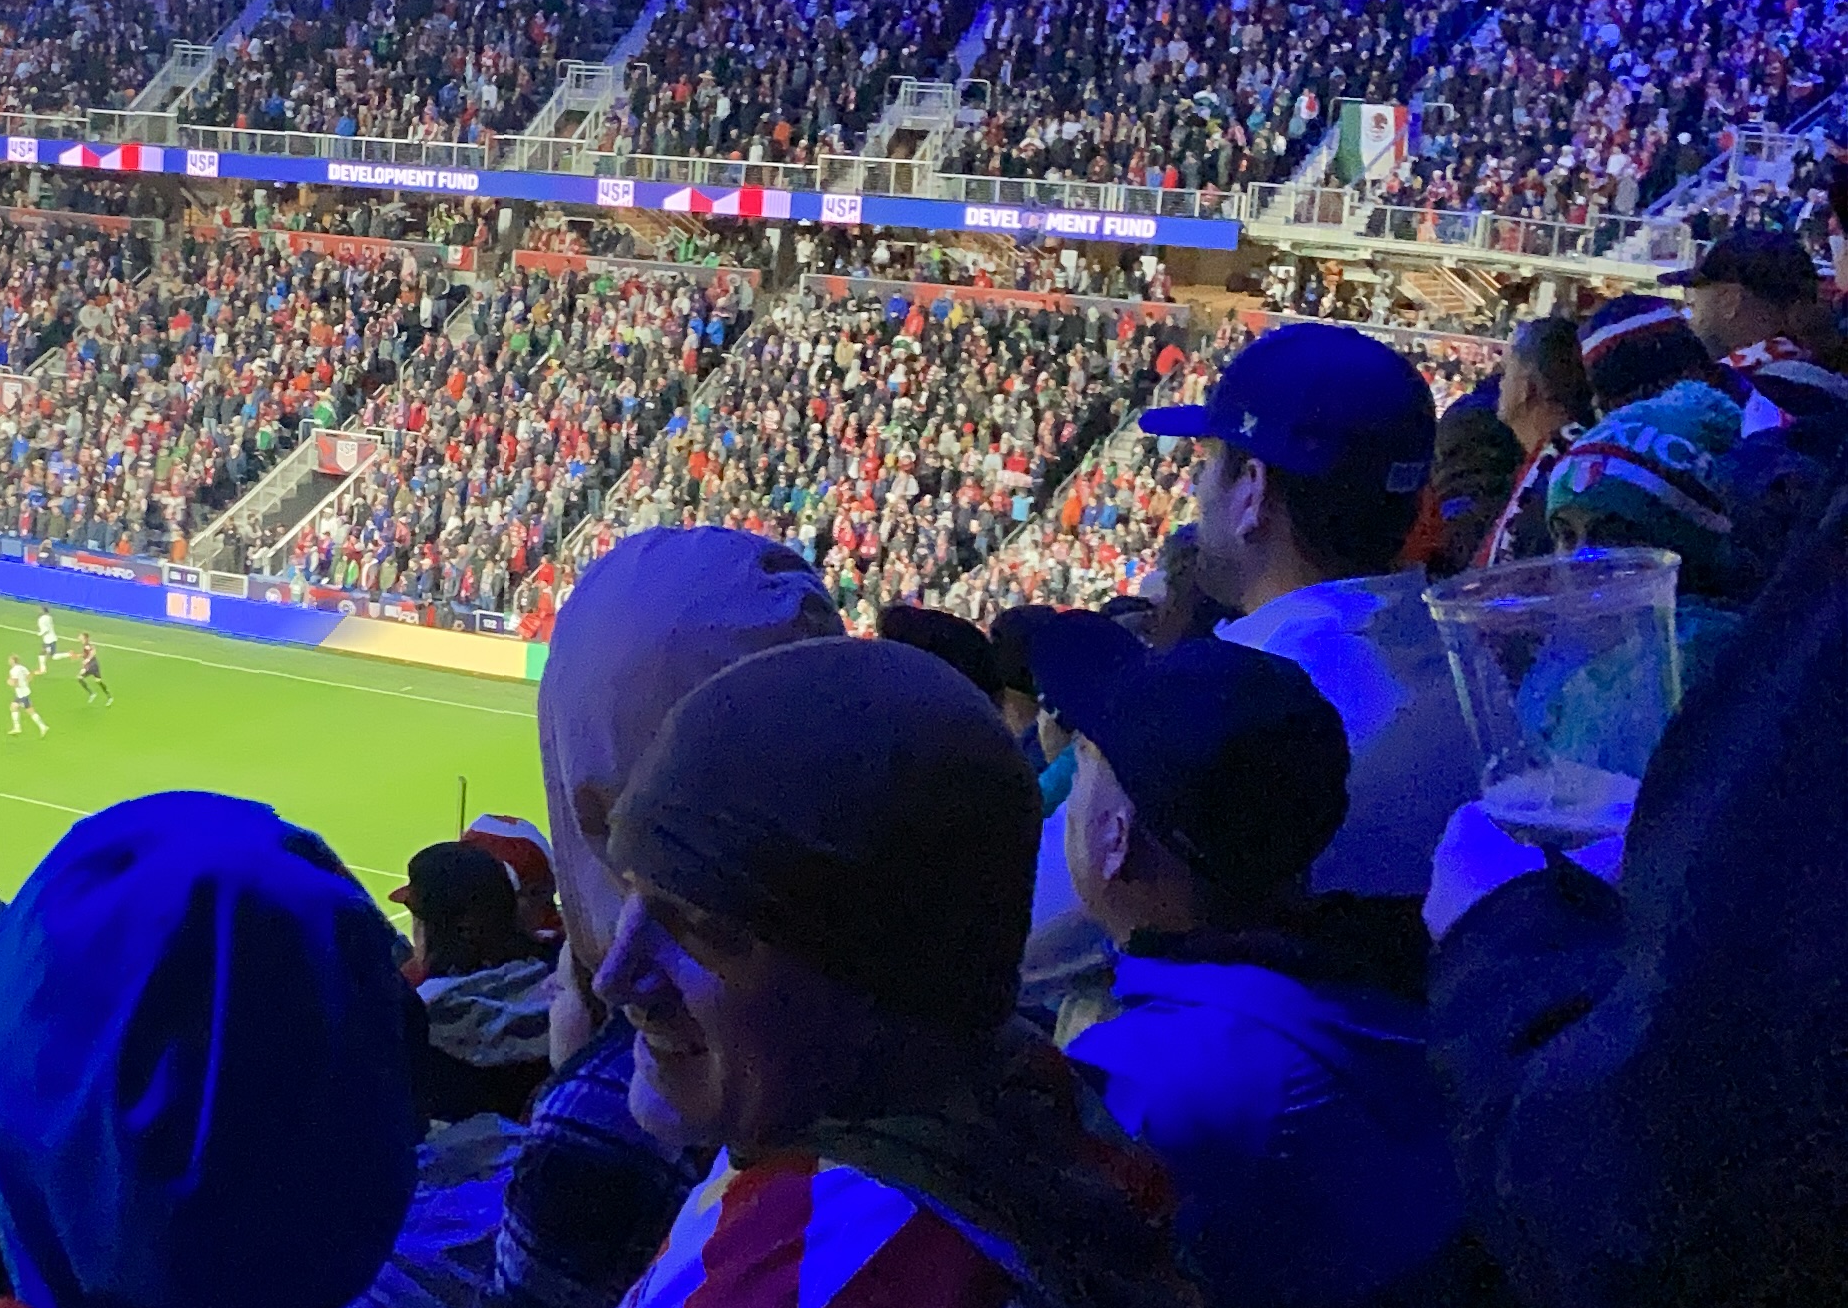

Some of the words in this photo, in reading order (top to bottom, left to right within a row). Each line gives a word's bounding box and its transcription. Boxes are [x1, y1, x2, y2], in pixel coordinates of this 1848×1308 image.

[189, 153, 216, 173] USA
[327, 162, 437, 188] DEVELOPMENT
[438, 170, 479, 192] FUND
[601, 182, 630, 200] USA
[825, 198, 858, 217] USA
[964, 206, 1101, 234] DEVELMENT
[1102, 217, 1157, 239] FUND
